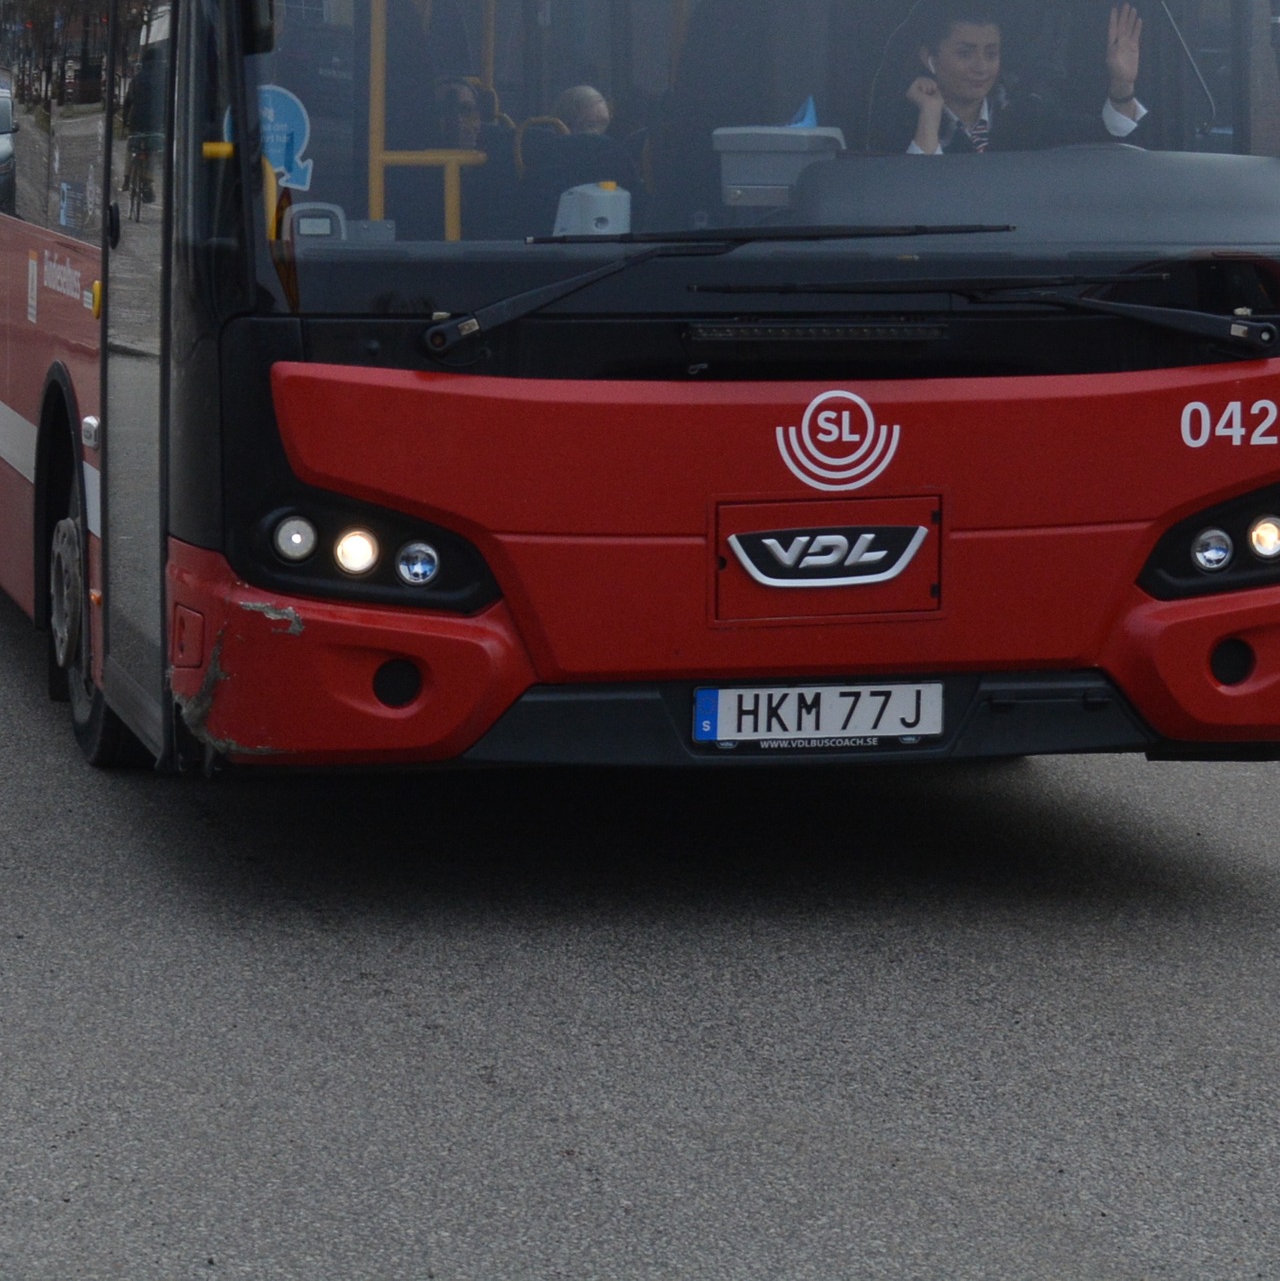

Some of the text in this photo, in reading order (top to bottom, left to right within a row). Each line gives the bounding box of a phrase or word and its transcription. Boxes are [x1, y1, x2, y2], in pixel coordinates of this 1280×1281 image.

[816, 410, 861, 443] SL
[760, 533, 890, 570] VDL
[701, 720, 711, 732] S
[736, 689, 922, 734] HKM 77J
[759, 737, 879, 750] WWW.VDLBUSCOACH.SE
